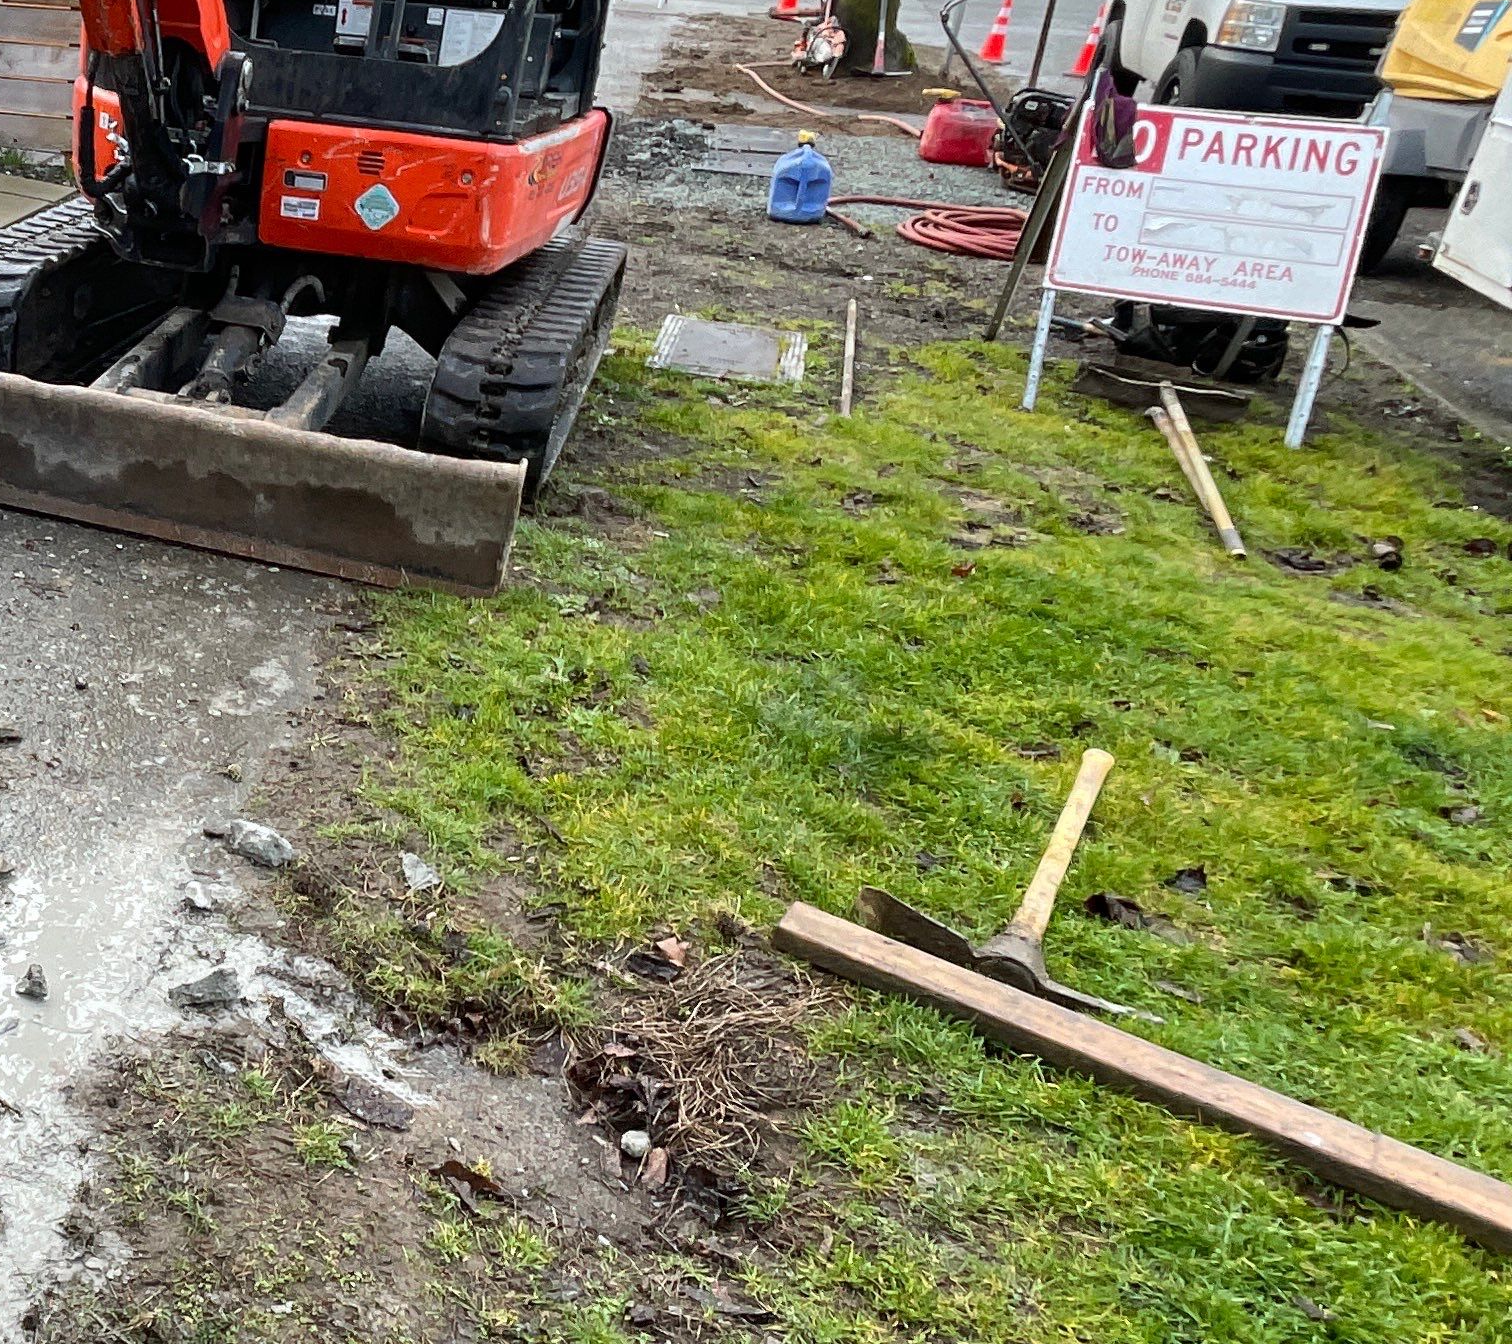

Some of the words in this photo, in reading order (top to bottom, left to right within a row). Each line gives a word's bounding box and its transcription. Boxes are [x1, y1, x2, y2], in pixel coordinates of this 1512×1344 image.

[1177, 126, 1362, 176] PARKING
[1082, 175, 1145, 200] FROM
[1092, 212, 1119, 233] TO
[1102, 244, 1218, 273] TOW-AWAY
[1233, 260, 1294, 283] AREA
[1131, 265, 1179, 281] PHONE
